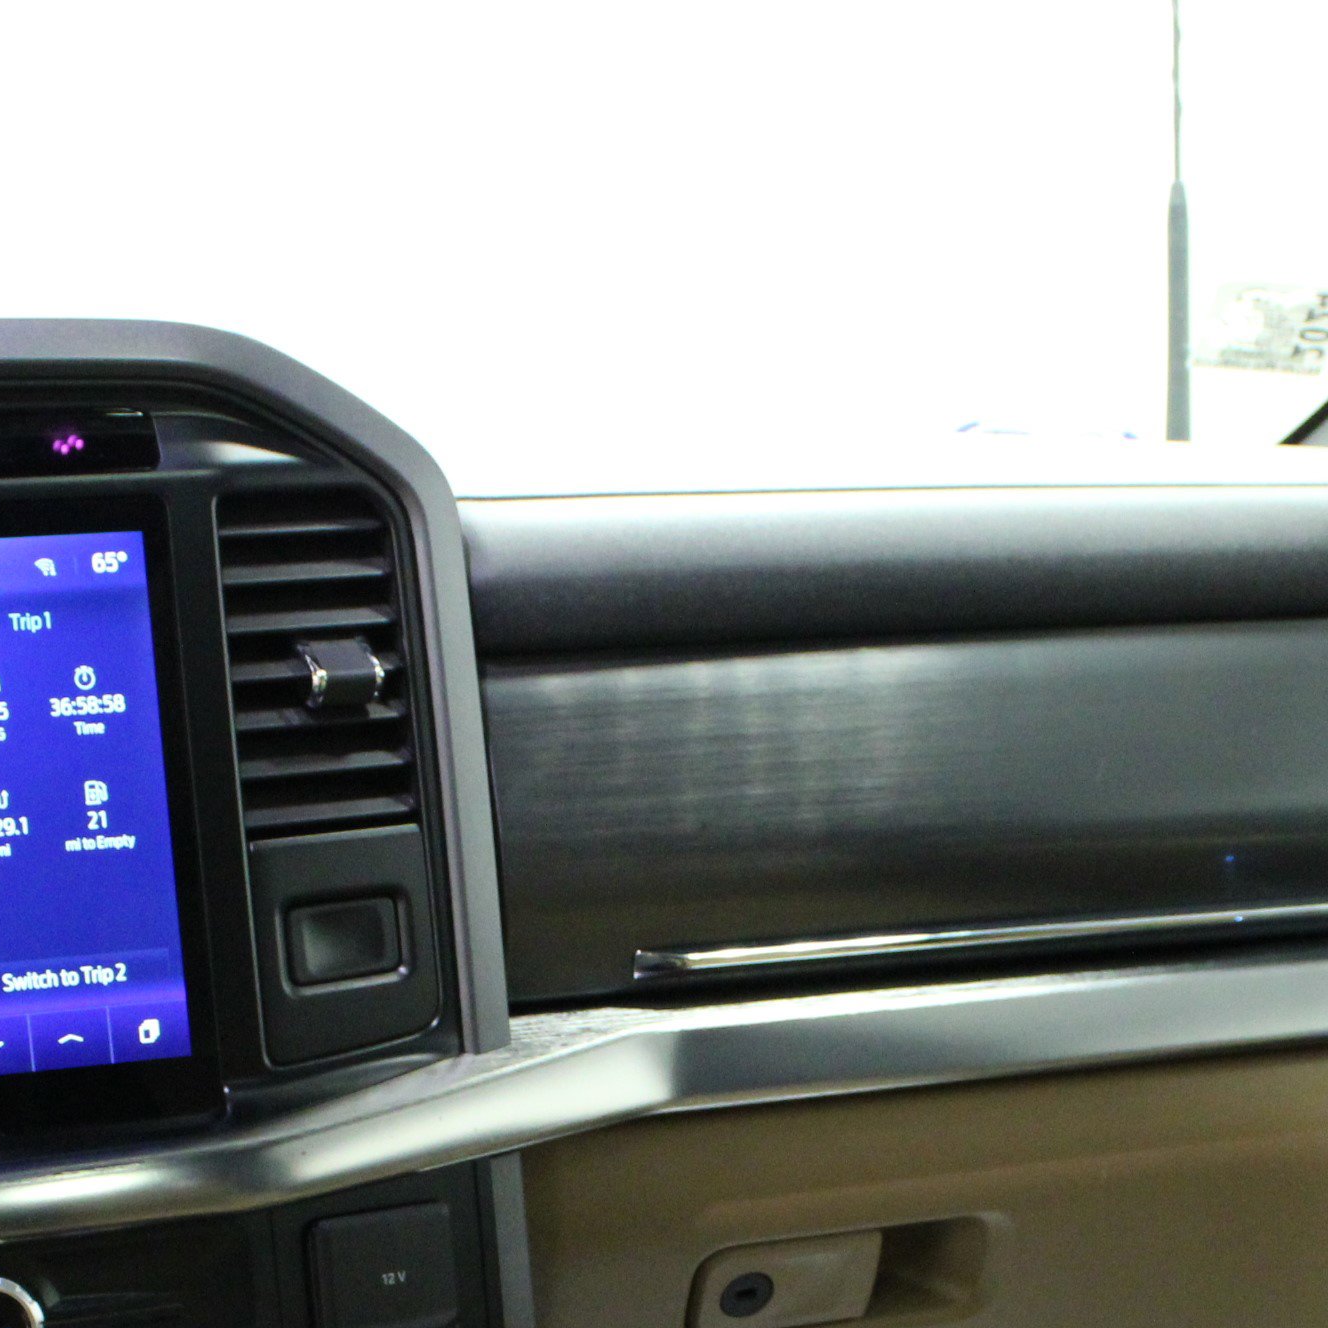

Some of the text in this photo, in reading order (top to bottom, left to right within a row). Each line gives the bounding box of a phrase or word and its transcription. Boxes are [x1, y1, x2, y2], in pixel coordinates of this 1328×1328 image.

[9, 612, 42, 633] Trip
[49, 693, 126, 718] 36:58:58
[74, 720, 105, 736] Time
[86, 811, 109, 831] 21
[65, 833, 136, 852] mi to Empty
[2, 963, 127, 993] Switch to Trip 2
